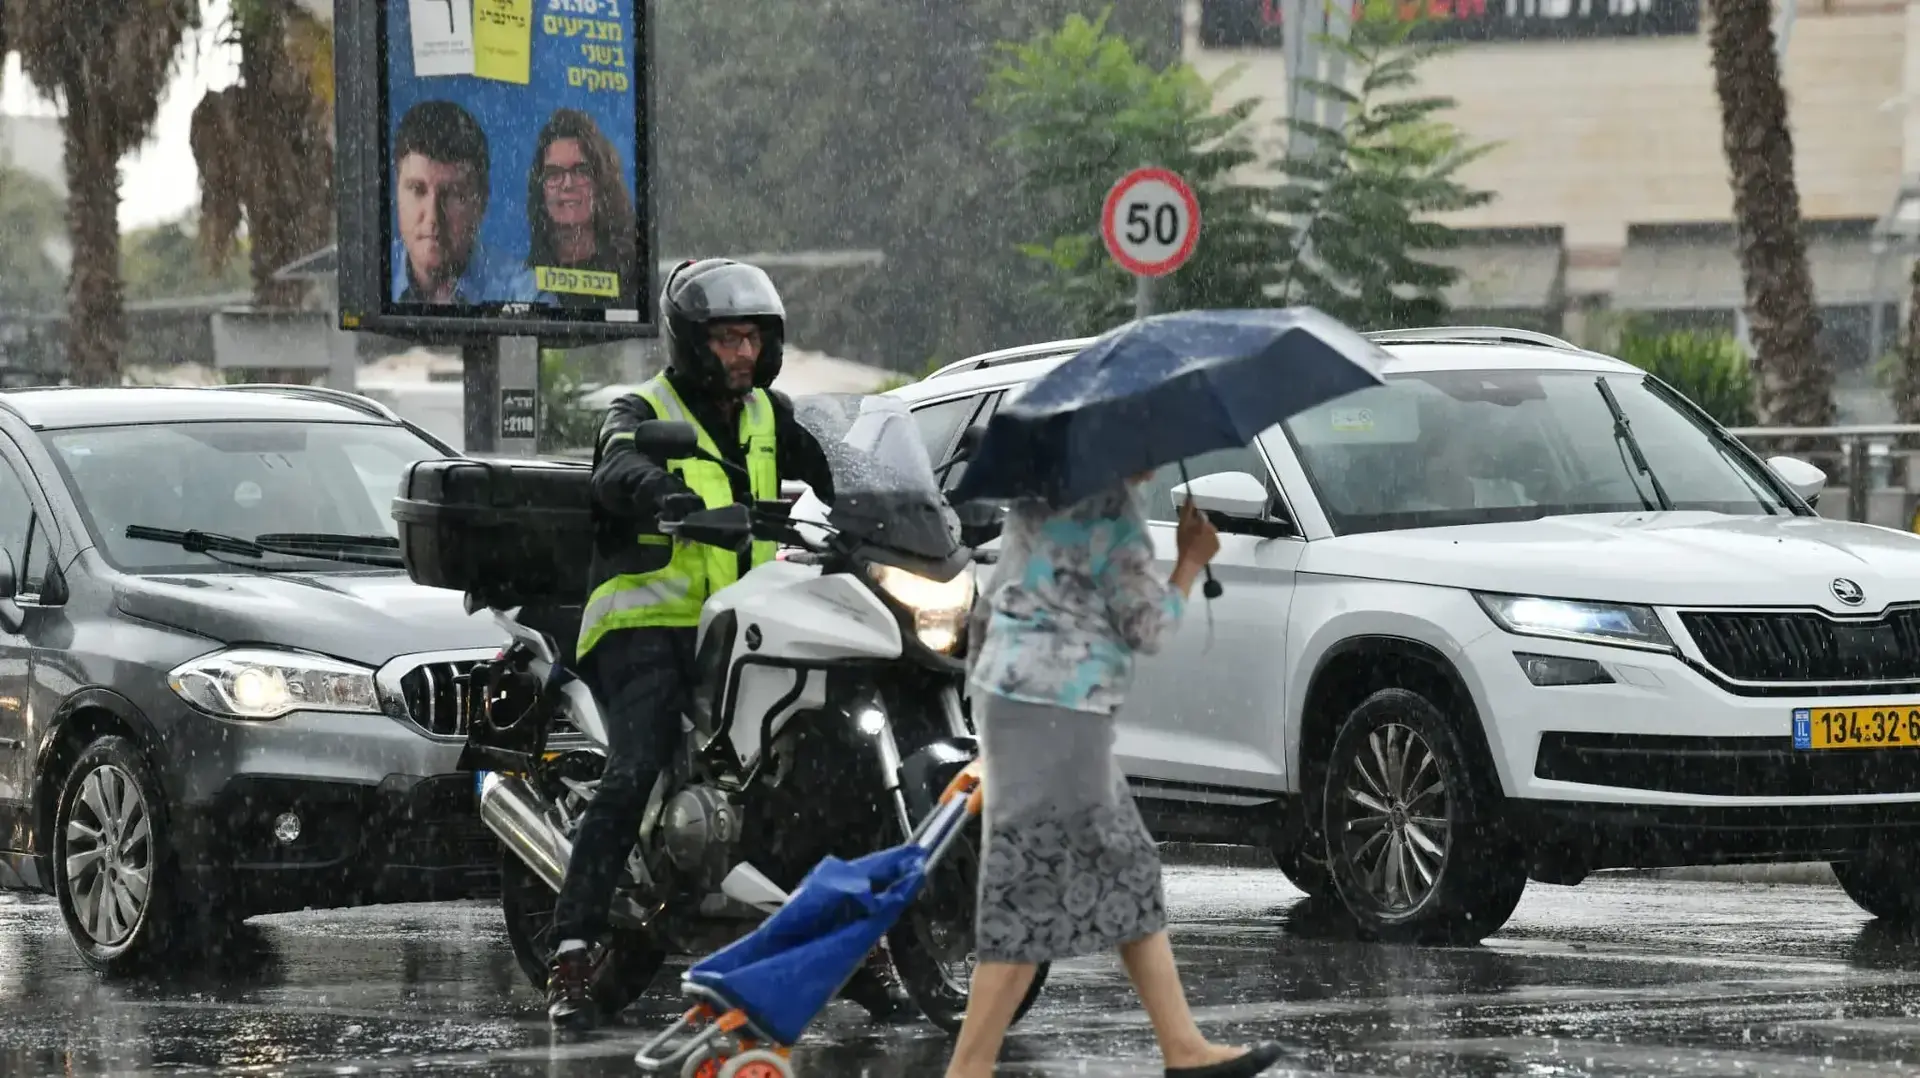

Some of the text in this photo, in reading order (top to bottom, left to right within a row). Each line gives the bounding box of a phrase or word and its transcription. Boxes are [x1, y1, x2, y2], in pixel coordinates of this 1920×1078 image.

[544, 14, 622, 41] מצביעים
[581, 43, 625, 67] בשני
[567, 66, 628, 93] פתקים
[1125, 202, 1179, 246] 50
[544, 267, 613, 291] ניבה קפלן
[1797, 721, 1808, 737] IL
